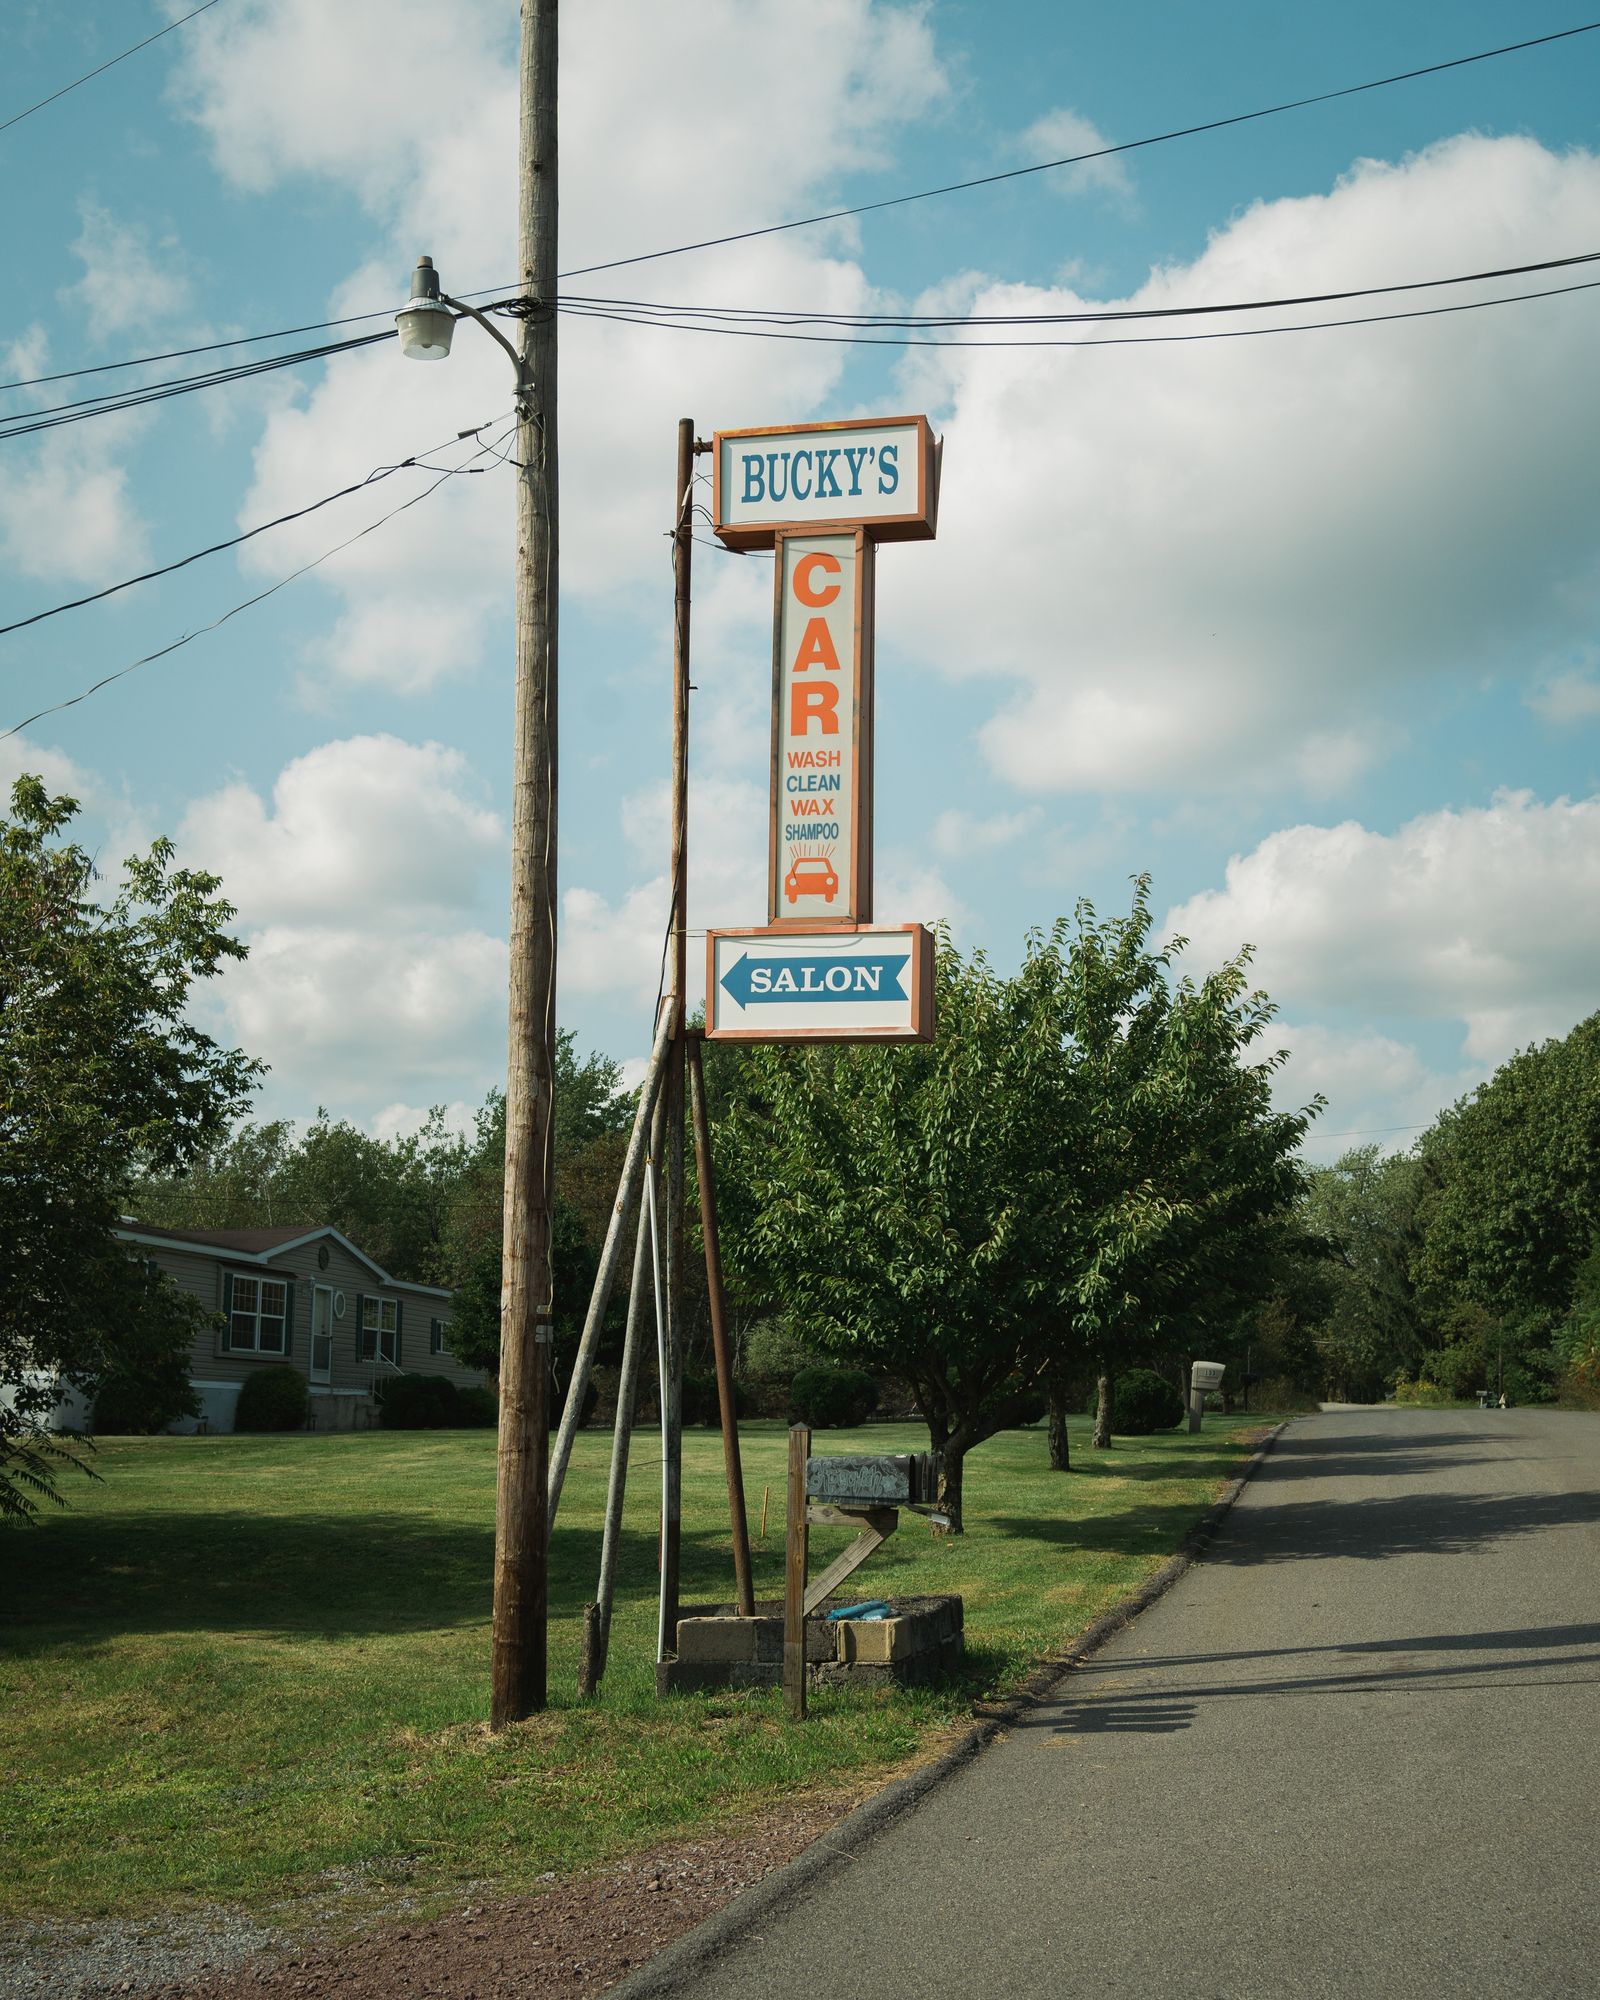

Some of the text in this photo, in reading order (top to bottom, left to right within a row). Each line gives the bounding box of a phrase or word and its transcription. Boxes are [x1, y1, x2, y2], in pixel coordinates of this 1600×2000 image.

[741, 445, 899, 503] BUCKY'S
[791, 552, 841, 736] CAR
[787, 750, 841, 768] WASH
[786, 774, 841, 792] CLEAN
[790, 798, 835, 816] WAX
[785, 822, 839, 841] SHAMPOO
[750, 966, 883, 993] SALON
